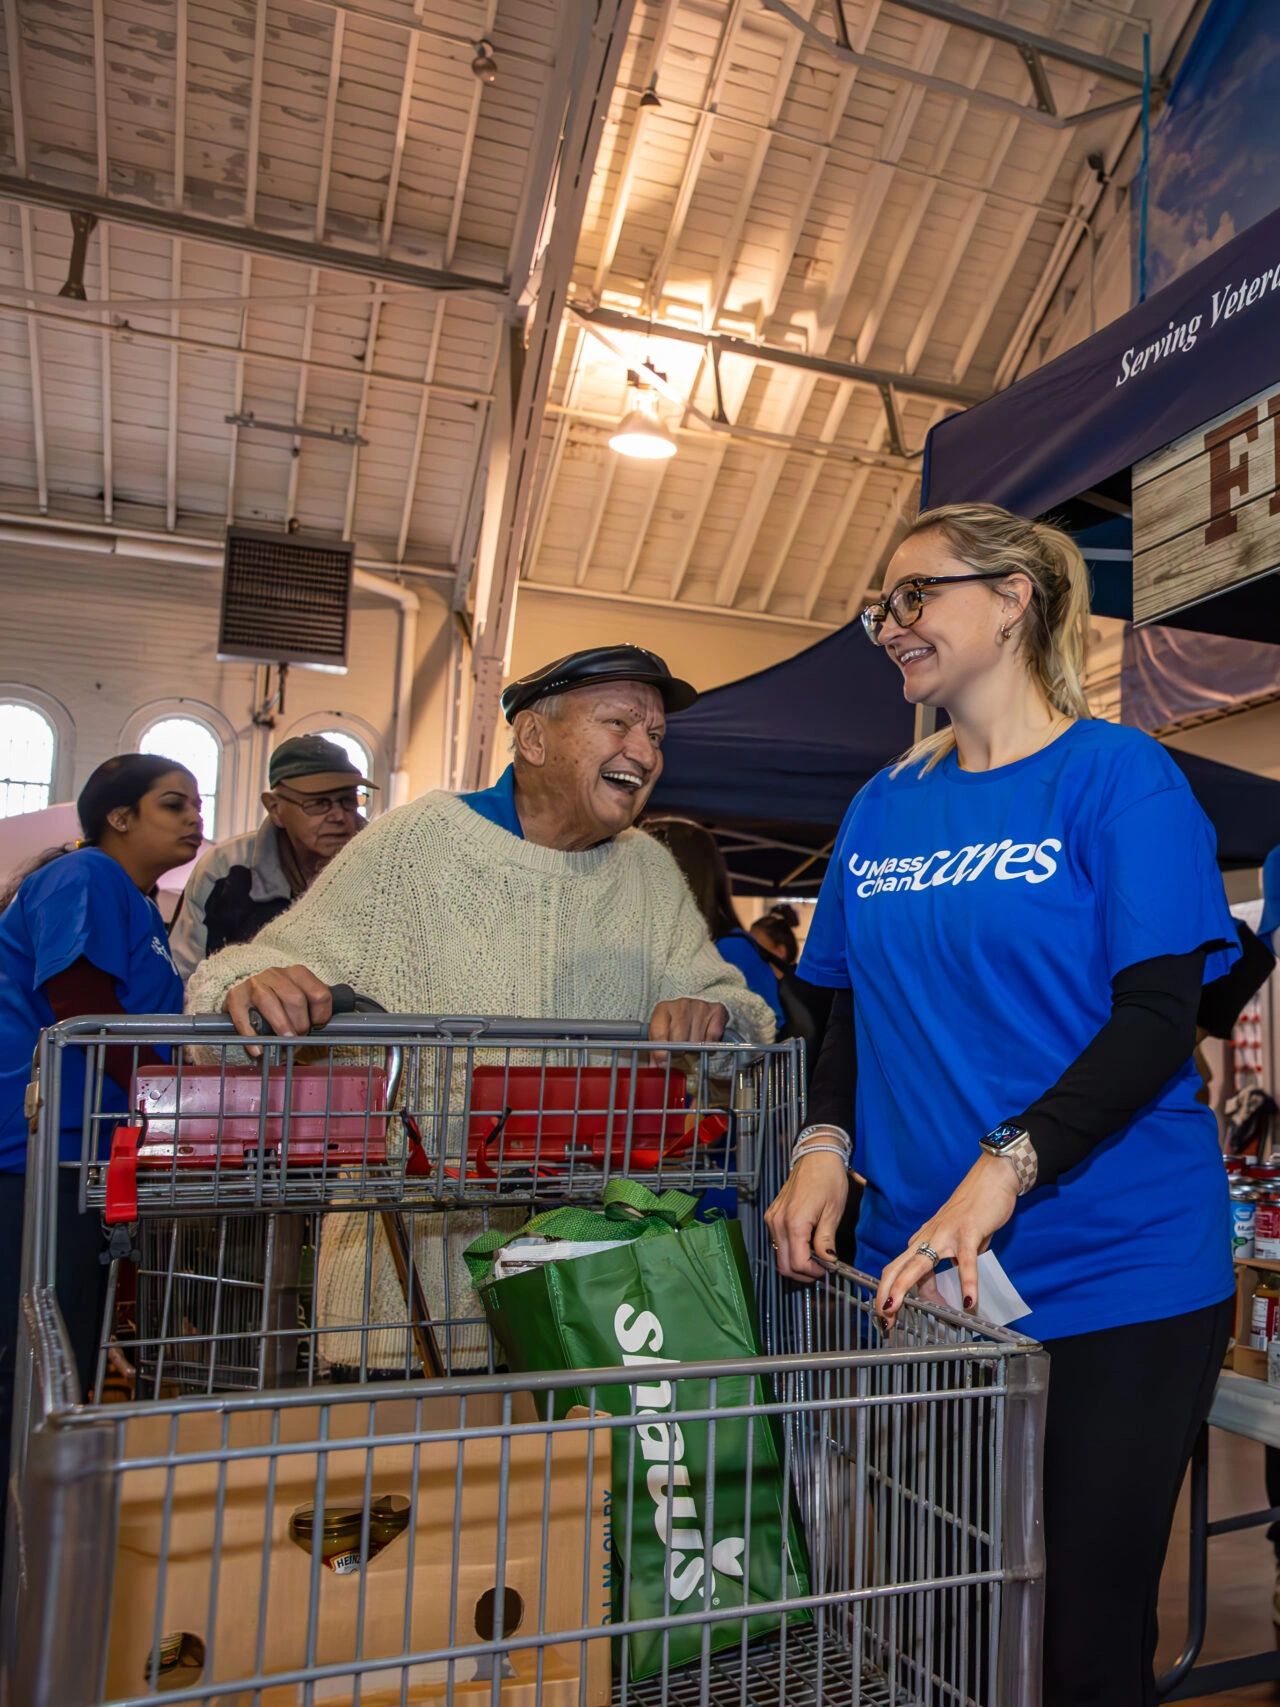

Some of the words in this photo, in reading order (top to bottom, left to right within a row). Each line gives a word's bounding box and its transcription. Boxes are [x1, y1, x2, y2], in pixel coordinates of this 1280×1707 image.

[1115, 314, 1203, 388] Serving
[848, 852, 925, 880] UMass
[910, 838, 1062, 892] cares
[856, 874, 914, 899] Chan
